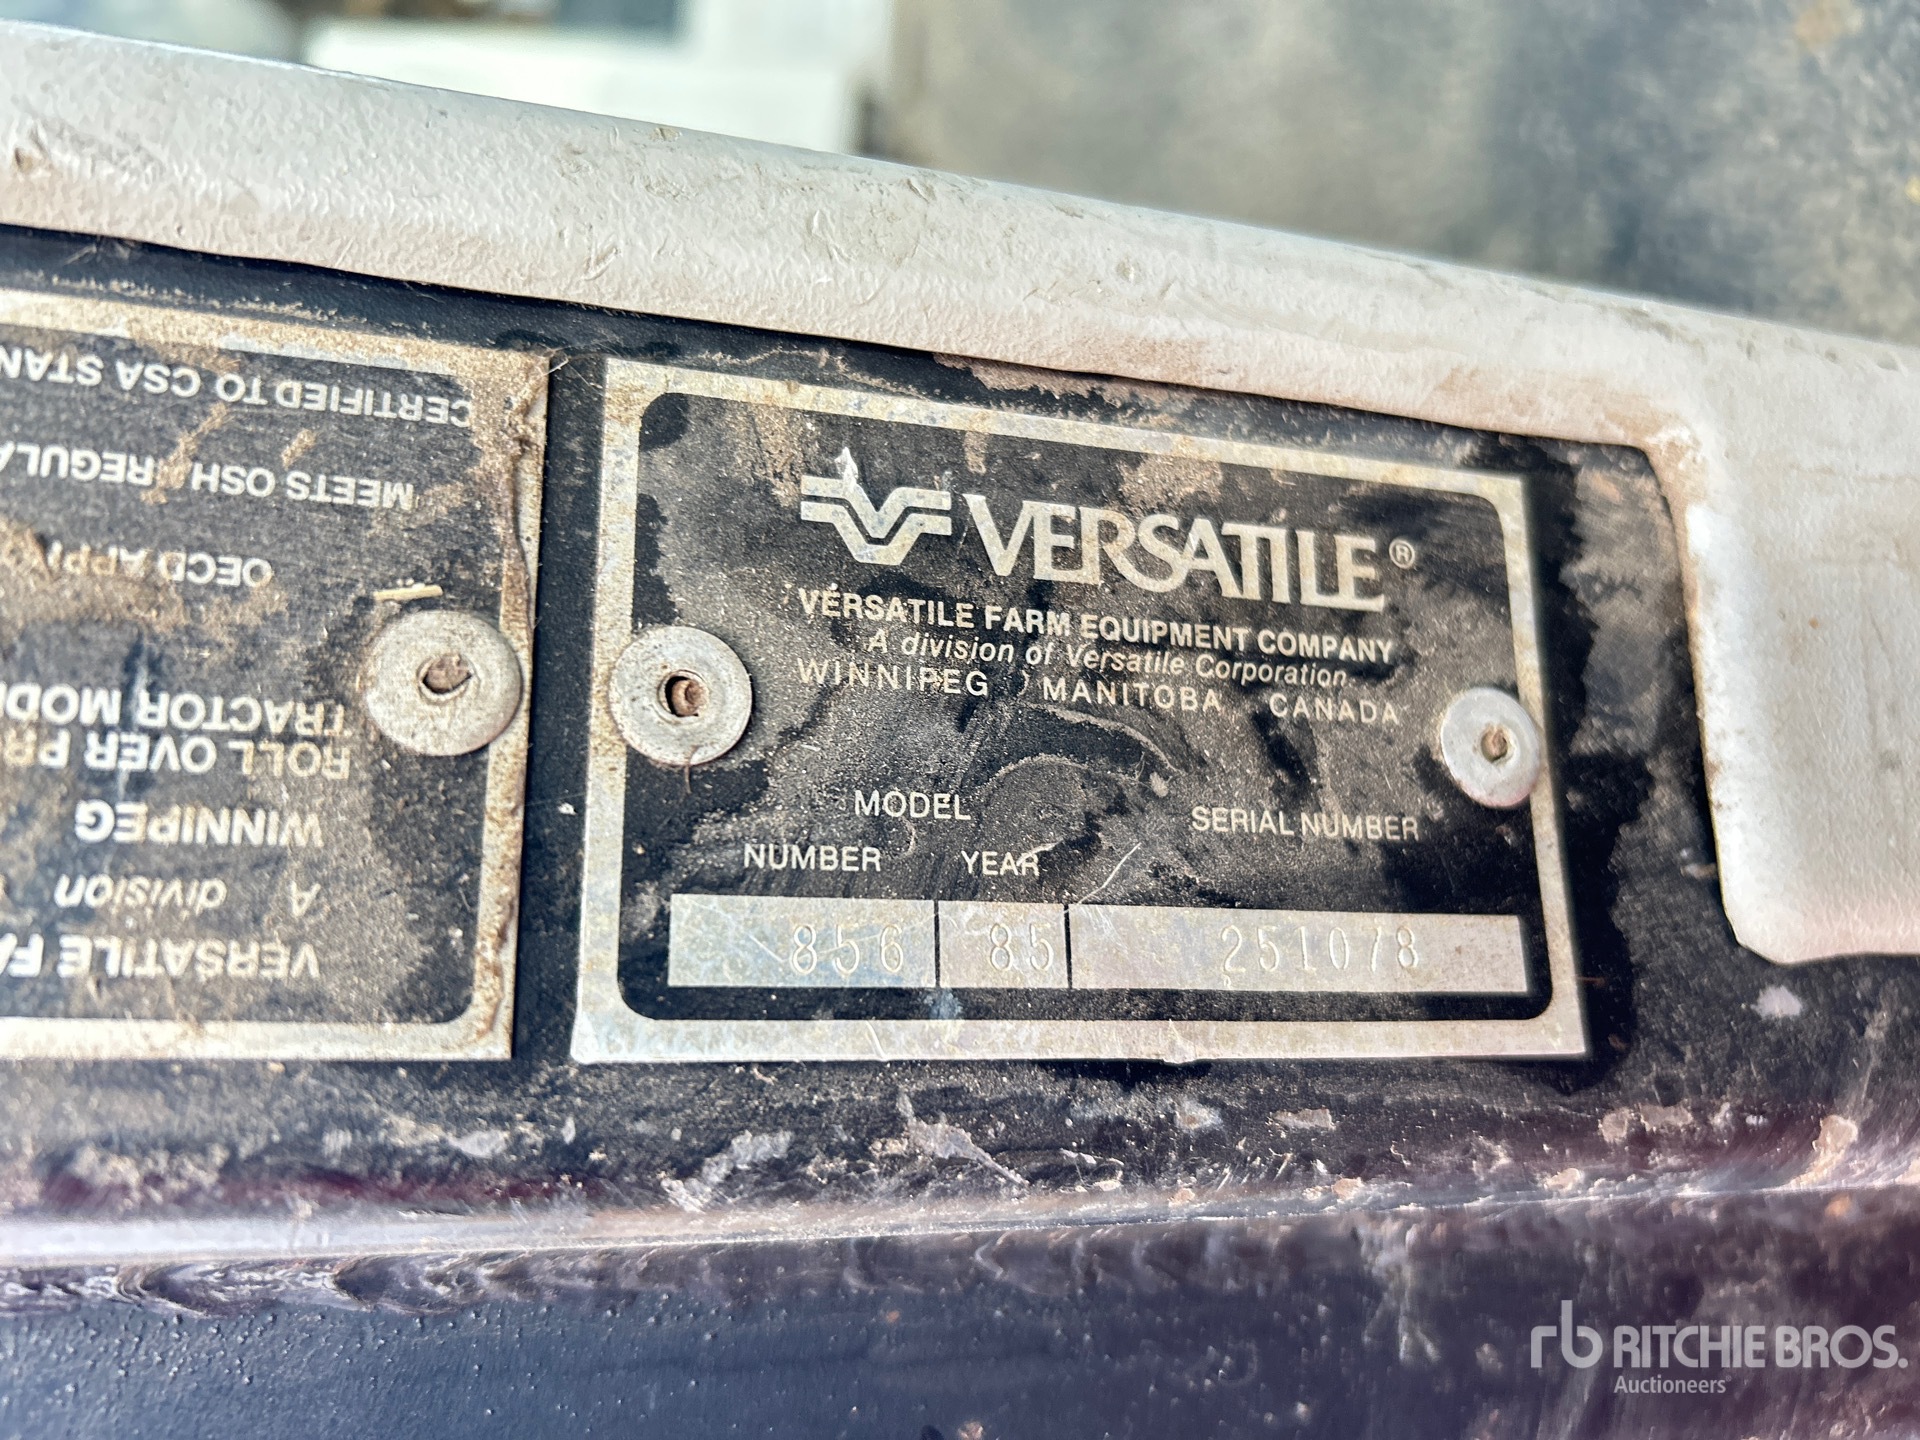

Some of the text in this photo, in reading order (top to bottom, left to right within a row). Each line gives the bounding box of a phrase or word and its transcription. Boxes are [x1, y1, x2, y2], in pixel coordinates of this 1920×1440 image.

[0, 344, 472, 428] CERTIFIED TO CSA STAN
[172, 461, 274, 497] OSH
[287, 470, 414, 510] MEETS
[158, 552, 273, 588] OECD
[798, 587, 1393, 664] VERSATILE FARM EQUIPMENT COMPANY
[868, 629, 1348, 687] A division of Versatile Corporation
[0, 681, 352, 737] TRACTOR MOD
[797, 658, 1400, 725] WINNIPEG MANITOBA CANADA
[84, 731, 217, 774] OVER
[228, 738, 350, 780] ROLL
[74, 800, 324, 848] WINNIPEG
[854, 790, 971, 821] MODEL
[1192, 805, 1420, 841] SERIAL NUMBER
[744, 843, 882, 873] NUMBER
[961, 850, 1040, 878] YEAR
[54, 873, 321, 917] A division
[57, 934, 320, 979] VERSATILE
[791, 924, 904, 975] 856
[989, 923, 1055, 973] 85
[1220, 925, 1419, 973] 251078
